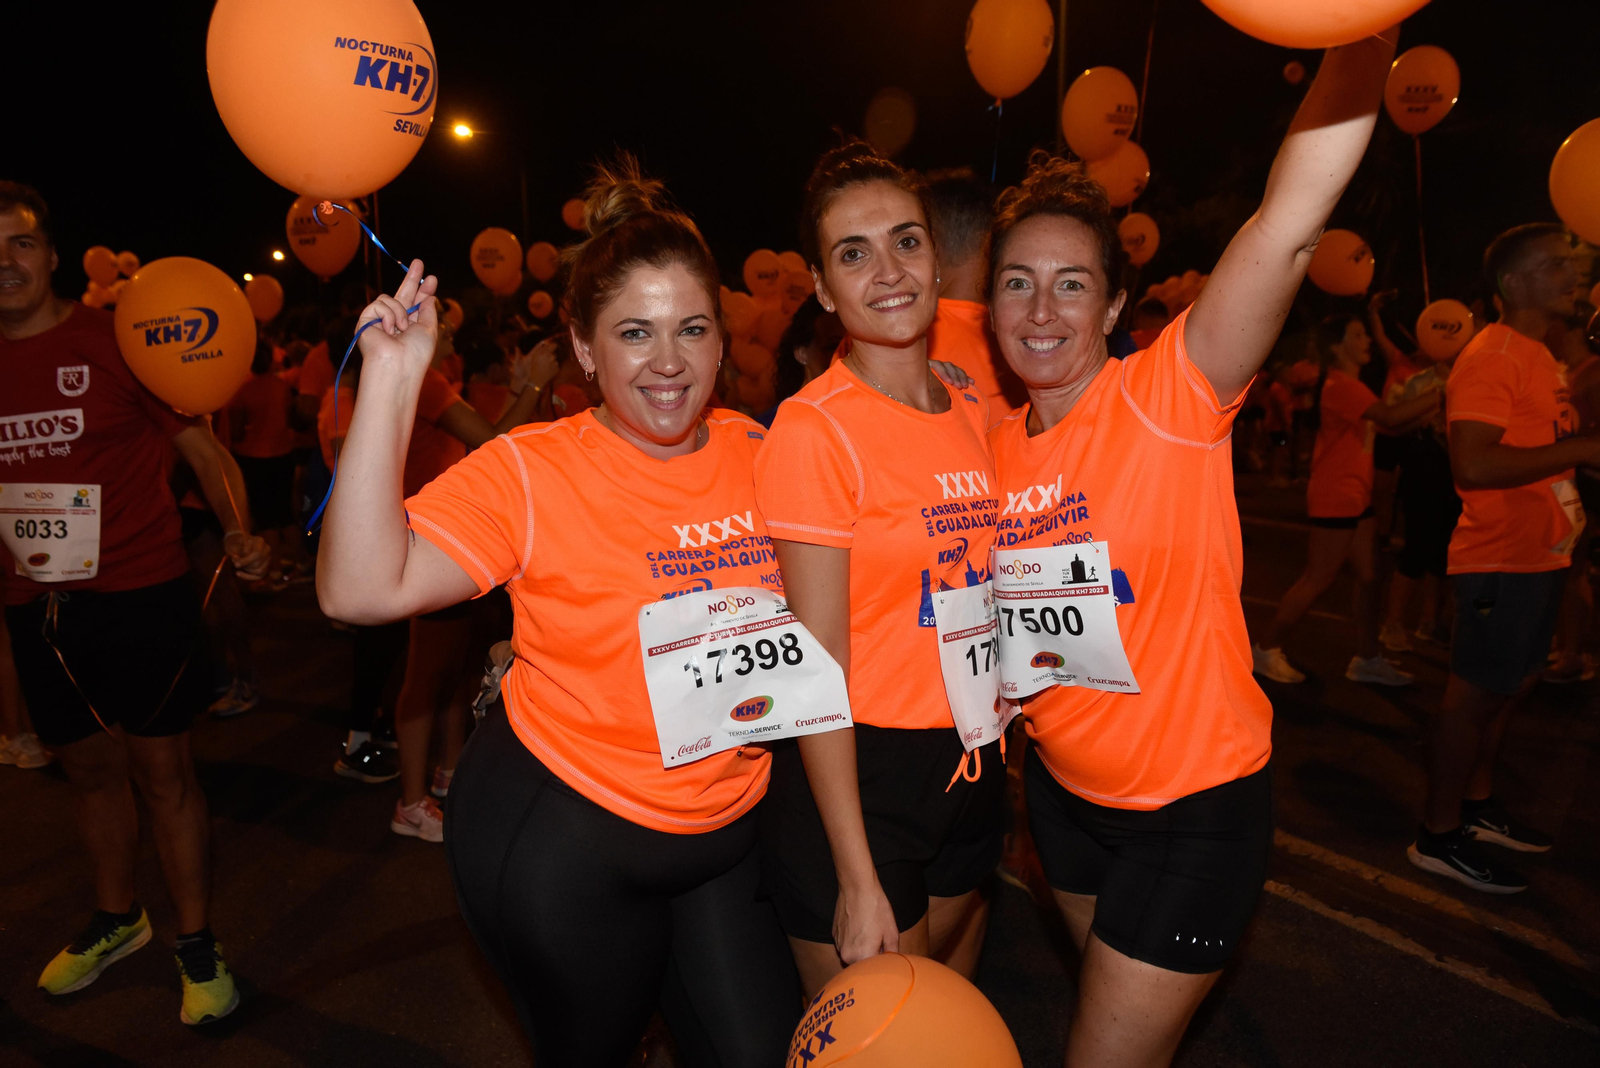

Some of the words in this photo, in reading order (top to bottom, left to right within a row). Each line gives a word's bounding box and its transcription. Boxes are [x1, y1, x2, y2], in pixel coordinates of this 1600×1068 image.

[334, 36, 413, 62] NOCTURNA
[132, 314, 181, 330] NOCTURNA
[181, 348, 224, 364] SEVILLA
[28, 444, 46, 459] the
[47, 441, 71, 458] best
[933, 470, 990, 500] XXXV
[1001, 473, 1063, 516] XXXV
[921, 503, 969, 519] CARRERA
[14, 518, 68, 539] 6033
[671, 510, 755, 549] XXXV
[926, 519, 936, 538] DEL
[646, 549, 716, 562] CARRERA
[650, 563, 660, 579] DEL
[1032, 588, 1076, 598] GUADALQUIVIR
[651, 642, 671, 655] XXXV
[670, 637, 700, 650] CARRERA
[736, 625, 747, 635] DEL
[747, 615, 791, 632] GUADALQUIVIR
[683, 632, 805, 689] 17398
[1087, 676, 1130, 688] Cruzcampo
[795, 713, 843, 728] Cruzcampo
[802, 998, 855, 1041] CARRERA
